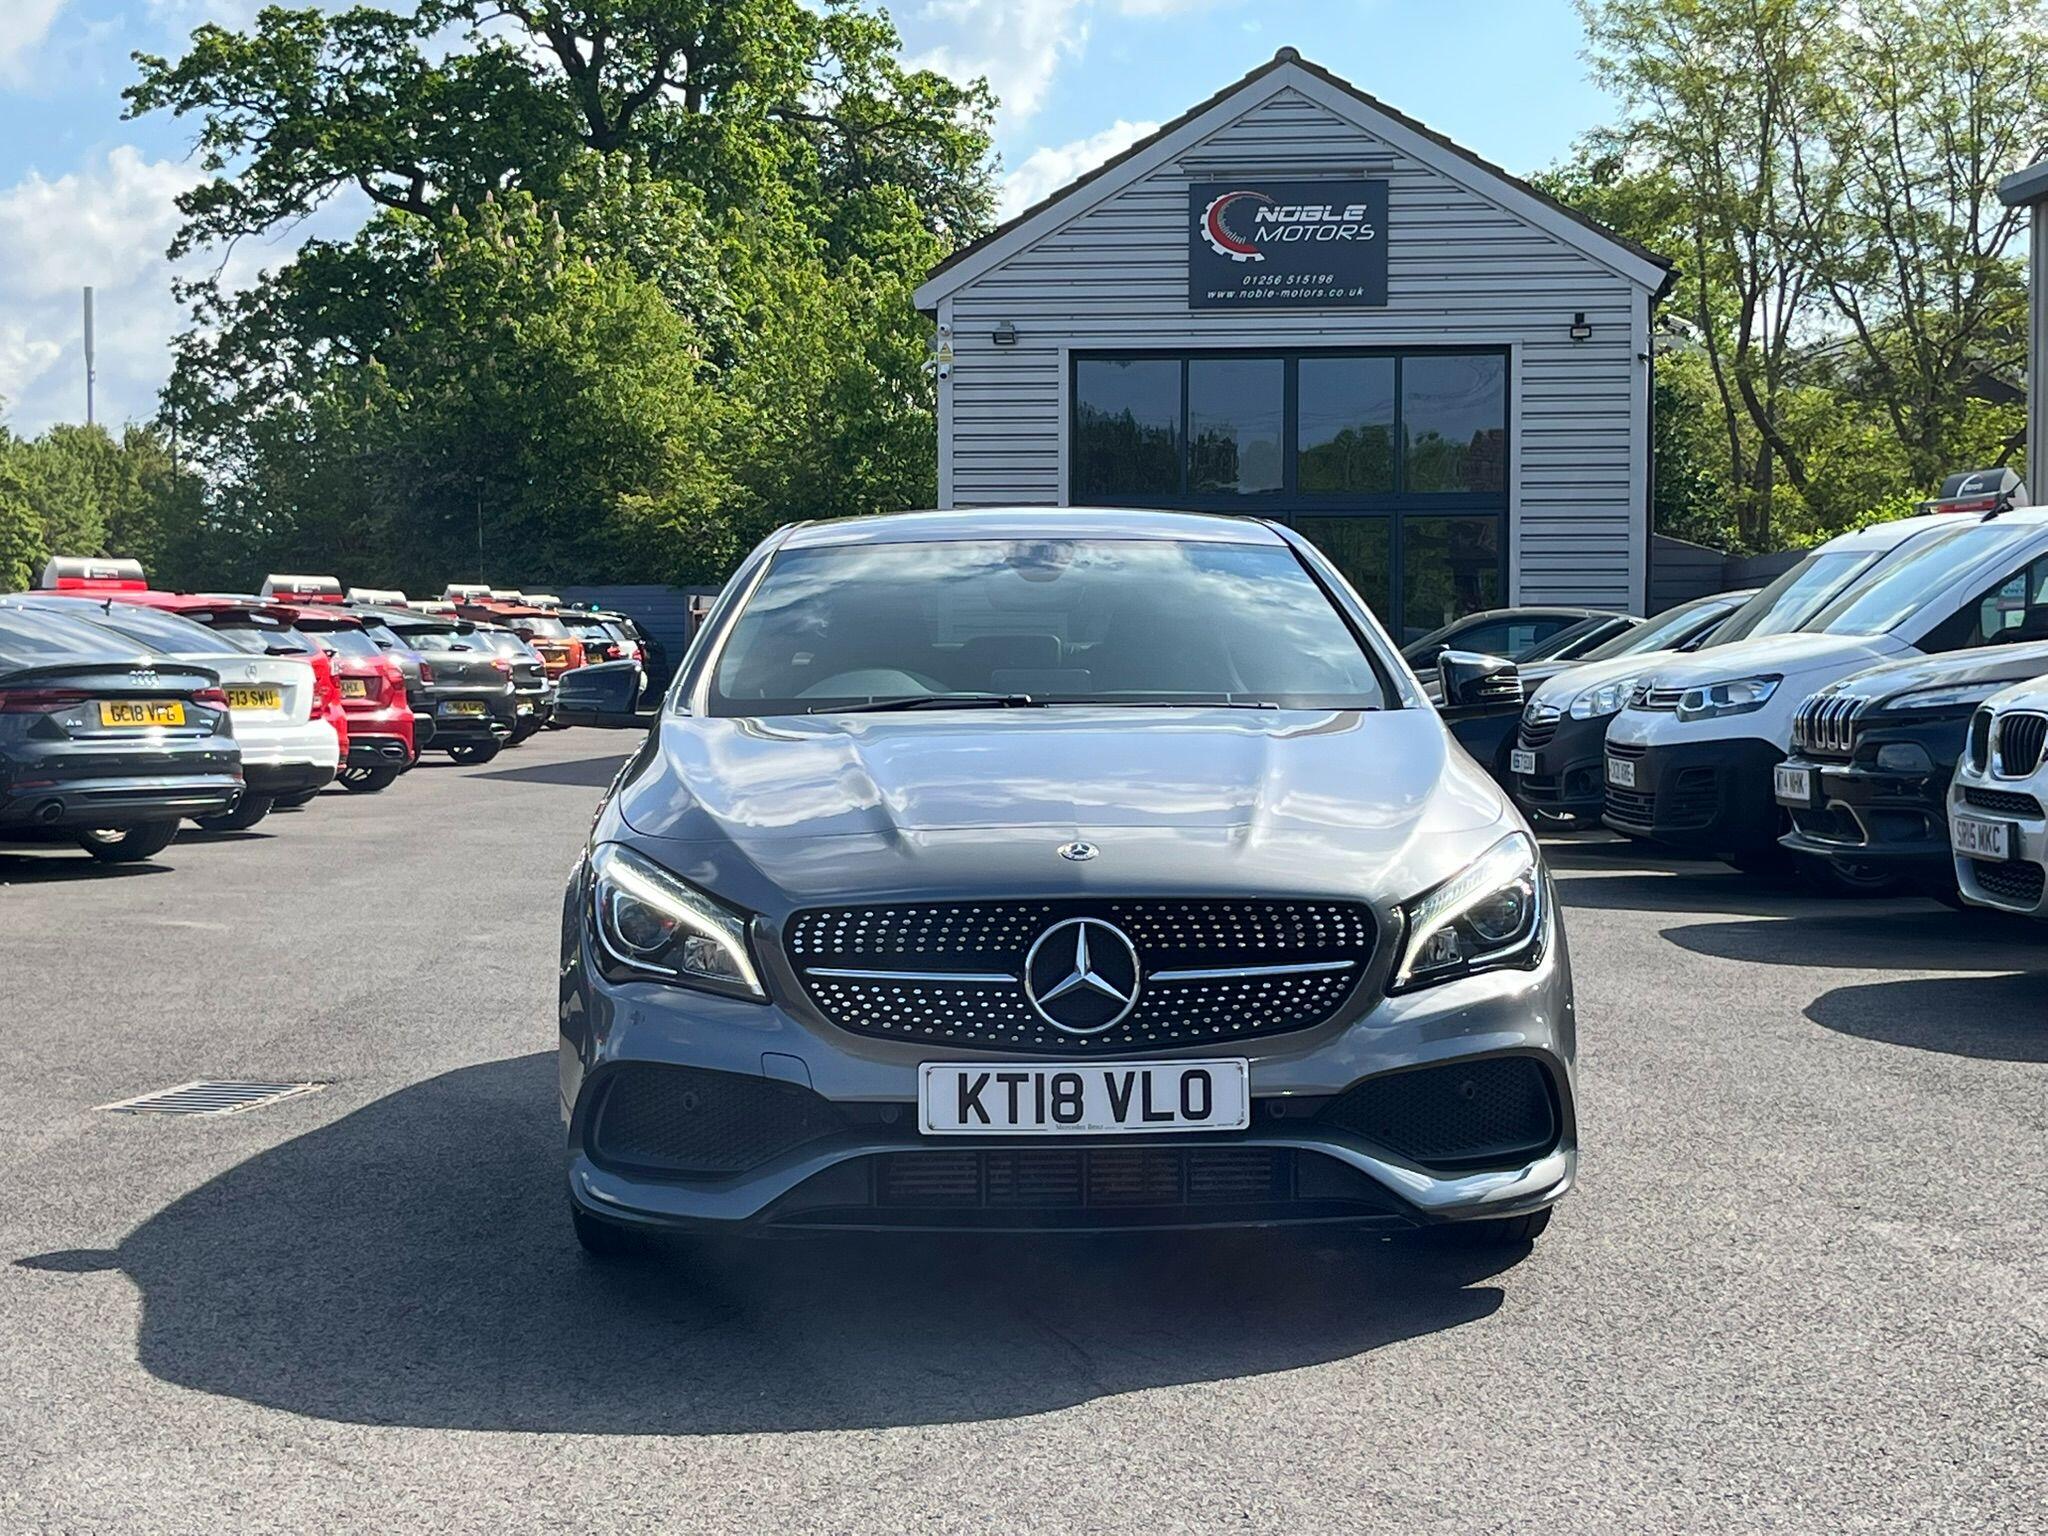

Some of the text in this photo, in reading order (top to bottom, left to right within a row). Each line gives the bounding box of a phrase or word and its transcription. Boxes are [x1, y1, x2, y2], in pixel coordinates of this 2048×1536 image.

[1255, 204, 1367, 223] NOBLE
[1255, 224, 1375, 242] MOTORS
[1242, 274, 1334, 286] 01256 515196
[957, 1068, 1213, 1125] KT18 VLO
